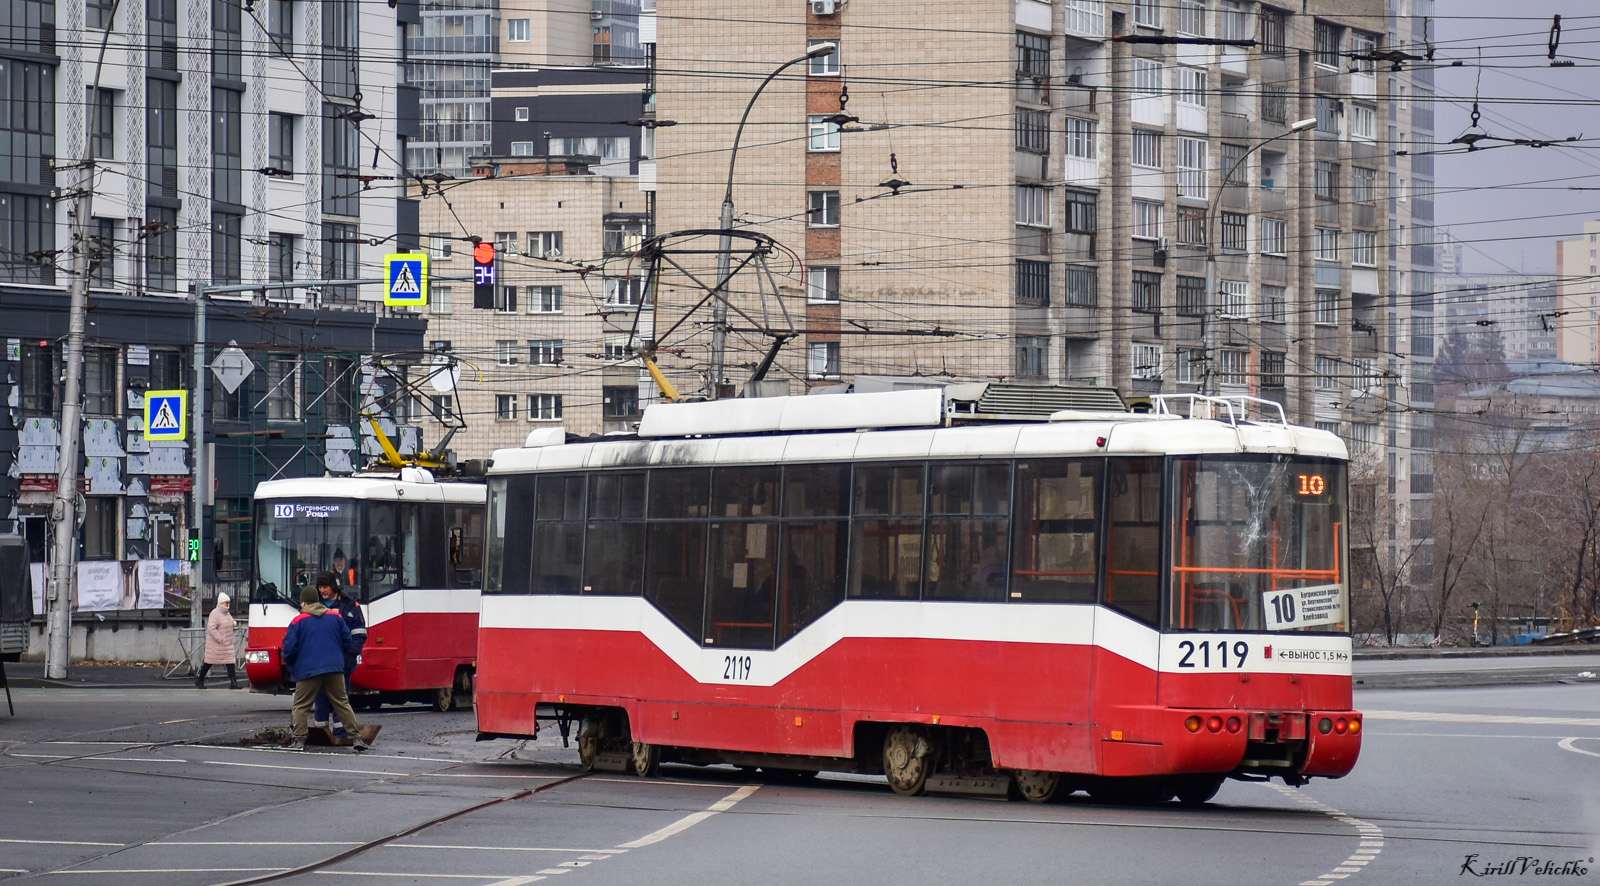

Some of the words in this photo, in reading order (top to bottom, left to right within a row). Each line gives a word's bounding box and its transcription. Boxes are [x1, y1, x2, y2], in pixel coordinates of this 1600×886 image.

[475, 266, 494, 285] 34
[1298, 475, 1324, 496] 10
[275, 505, 293, 517] 10
[296, 504, 340, 512] Бугринская
[305, 510, 329, 518] Роща
[188, 539, 200, 550] 30
[1271, 593, 1296, 624] 10
[1178, 640, 1249, 669] 2119
[1288, 650, 1321, 660] ВЫНОС
[1323, 651, 1335, 661] 1,5
[723, 655, 752, 681] 2119
